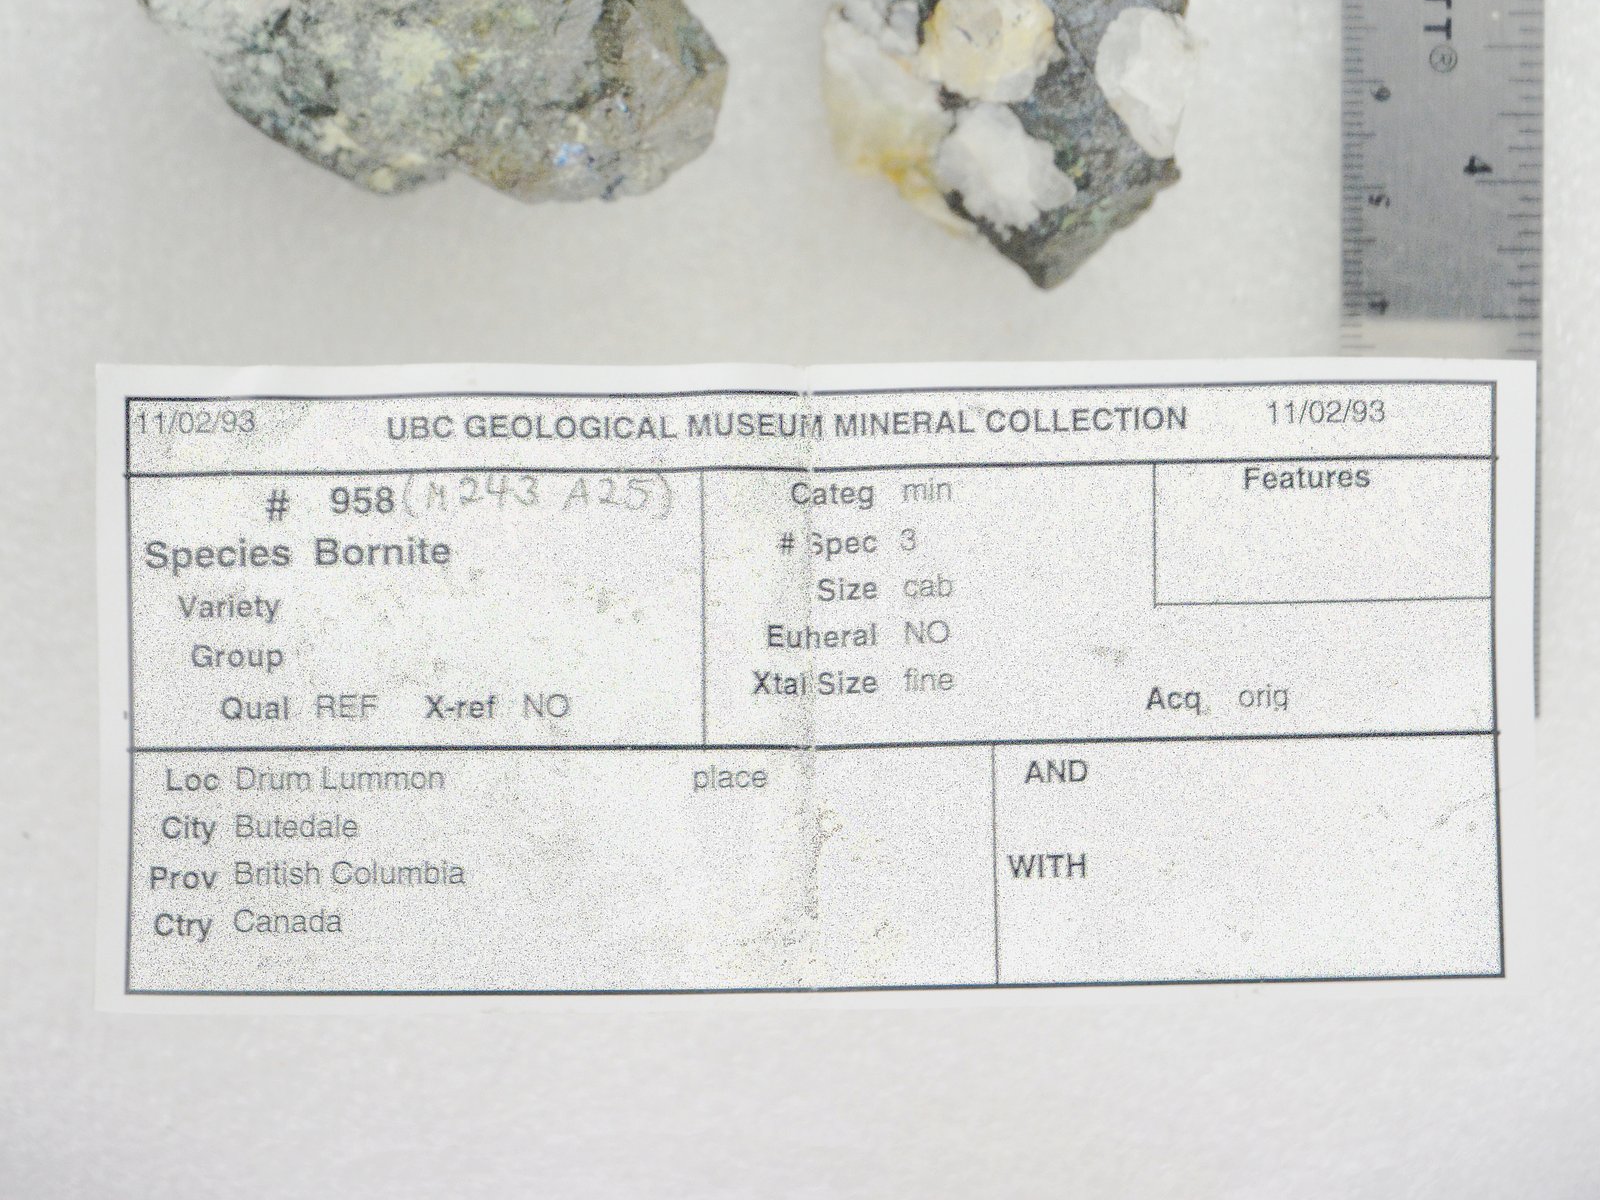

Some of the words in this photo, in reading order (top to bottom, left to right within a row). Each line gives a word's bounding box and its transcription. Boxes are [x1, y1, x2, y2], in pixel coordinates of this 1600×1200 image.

[1370, 83, 1391, 101] 6
[1463, 155, 1493, 175] 4
[135, 408, 257, 437] 11/02/93
[386, 414, 453, 441] UBC
[465, 412, 678, 440] GEOLOGICAL
[687, 410, 824, 438] MUSEUM
[835, 409, 976, 437] MINERAL
[985, 406, 1188, 435] COLLECTION
[1265, 399, 1387, 427] 11/02/93
[790, 480, 875, 511] Categ
[901, 476, 953, 503] min
[1242, 466, 1372, 491] Features
[266, 488, 290, 521] #
[329, 486, 395, 516] 958
[145, 539, 292, 575] Species
[315, 537, 452, 567] Bornite
[807, 532, 877, 561] Spec
[901, 528, 917, 552] 3
[816, 578, 879, 603] Size
[902, 574, 954, 599] cab
[177, 595, 281, 625] Variety
[766, 623, 878, 650] Euheral
[903, 620, 951, 646] NO
[191, 645, 284, 676] Group
[752, 669, 808, 697] Xtal
[816, 672, 879, 698] Size
[903, 666, 954, 693] fine
[219, 695, 290, 722] Qual
[315, 694, 378, 719] REF
[424, 694, 497, 721] X-ref
[523, 693, 571, 719] NO
[1145, 685, 1203, 716] Acq
[1238, 684, 1290, 713] orig
[165, 767, 220, 793] Loc
[236, 766, 311, 792] Drum
[322, 765, 446, 792] Lummon
[693, 764, 769, 794] place
[1024, 759, 1089, 785] AND
[161, 815, 217, 846] City
[235, 814, 359, 840] Butedale
[149, 866, 218, 892] Prov
[234, 861, 322, 888] British
[332, 860, 466, 887] Columbia
[1008, 853, 1088, 879] WITH
[153, 913, 214, 944] Ctry
[233, 910, 343, 936] Canada
